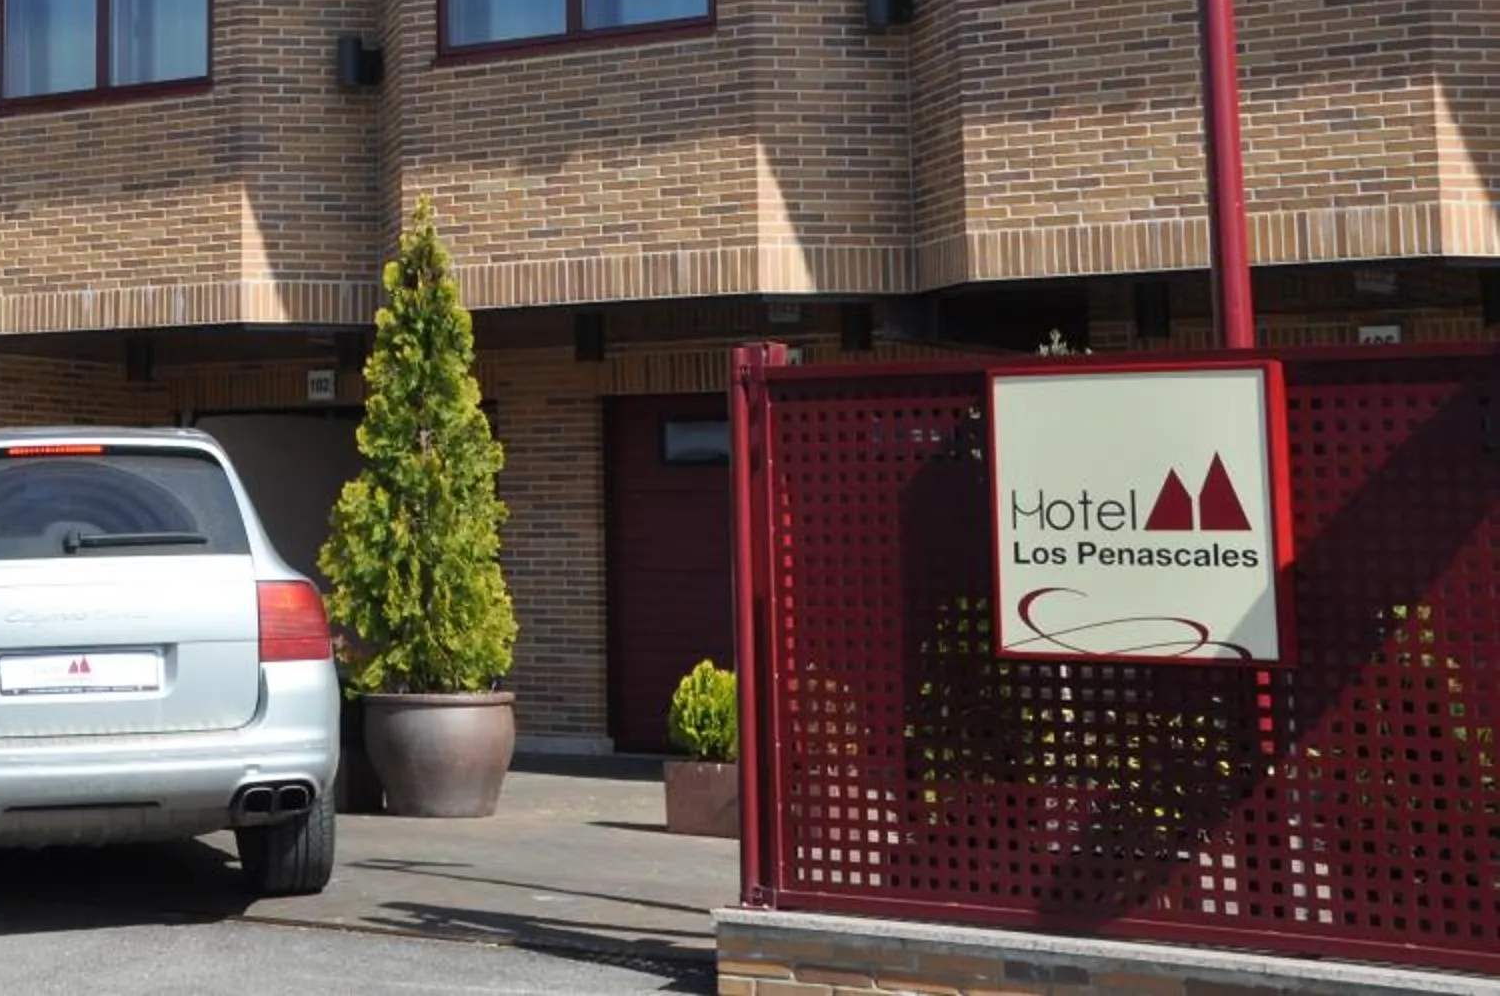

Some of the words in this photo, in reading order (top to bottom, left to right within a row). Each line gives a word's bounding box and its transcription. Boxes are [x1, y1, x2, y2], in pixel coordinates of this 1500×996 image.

[1011, 488, 1138, 531] Hotel
[1013, 541, 1067, 565] Los
[1077, 541, 1259, 568] Penascales
